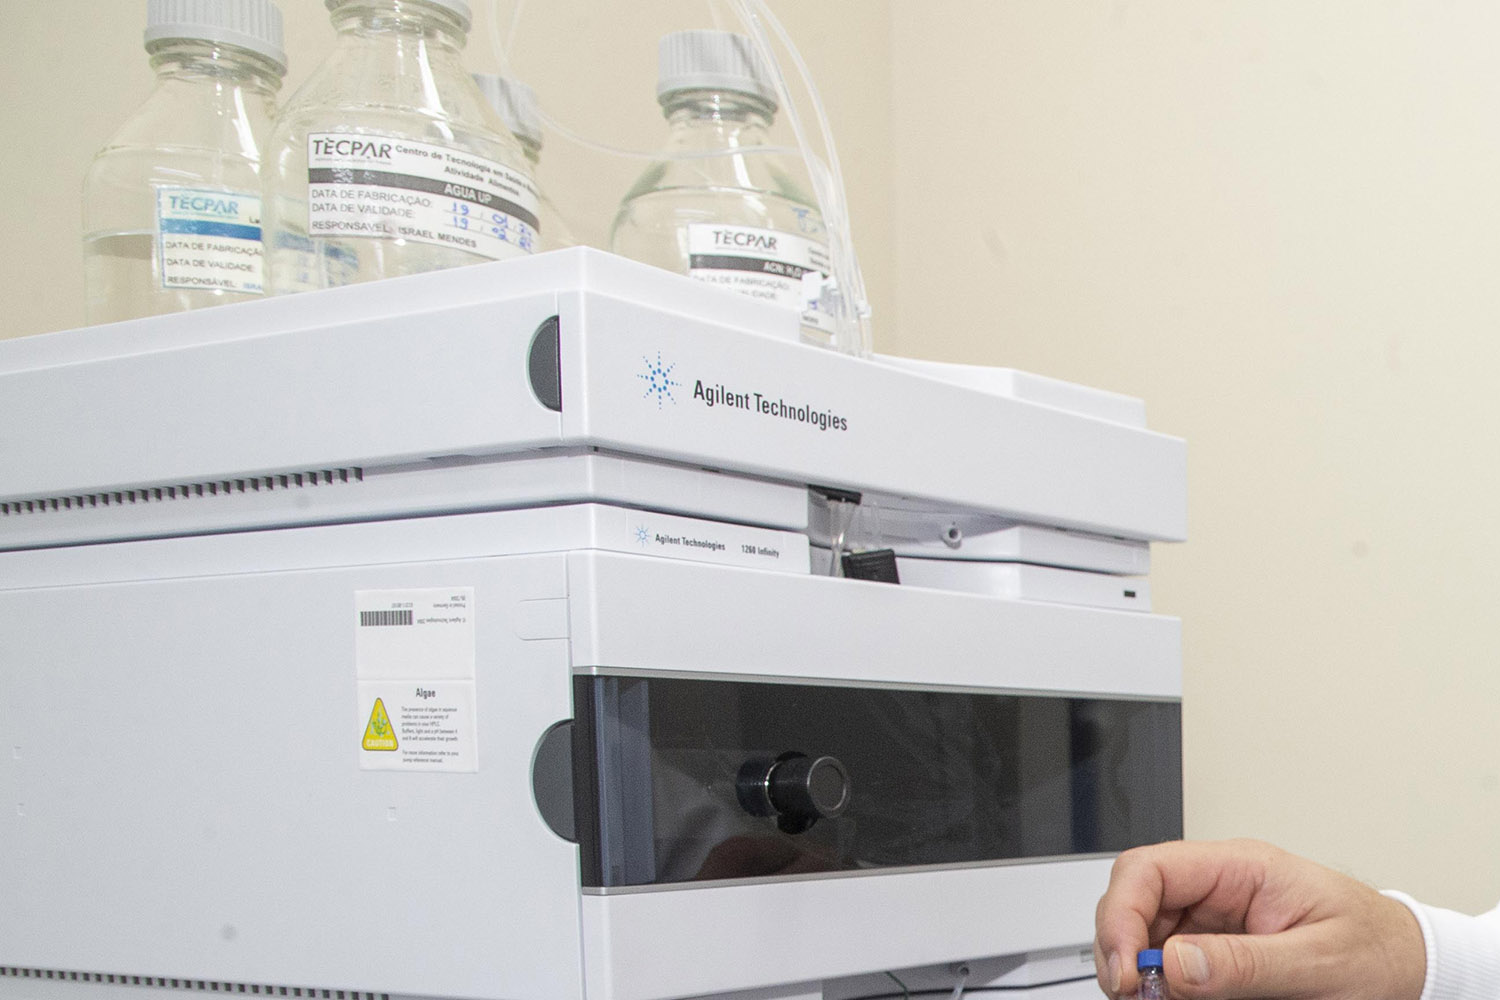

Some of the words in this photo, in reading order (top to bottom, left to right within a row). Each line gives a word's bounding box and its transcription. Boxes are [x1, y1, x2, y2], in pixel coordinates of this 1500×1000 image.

[395, 145, 428, 157] Centro
[431, 151, 442, 160] de
[446, 154, 491, 173] Tecnologia
[312, 190, 337, 199] DATA
[340, 190, 354, 199] DE
[312, 203, 337, 212] DATA
[340, 203, 355, 213] DE
[398, 226, 434, 239] ISRAEL
[437, 232, 477, 248] MENDES
[166, 241, 190, 250] DATA
[191, 242, 204, 251] DE
[167, 258, 190, 267] DATA
[192, 259, 205, 267] DE
[693, 379, 750, 410] Agilent
[753, 393, 848, 432] Technologies
[655, 533, 681, 546] Agilent
[682, 536, 726, 551] Technologies
[757, 546, 780, 558] Infinity
[416, 688, 436, 699] Algae
